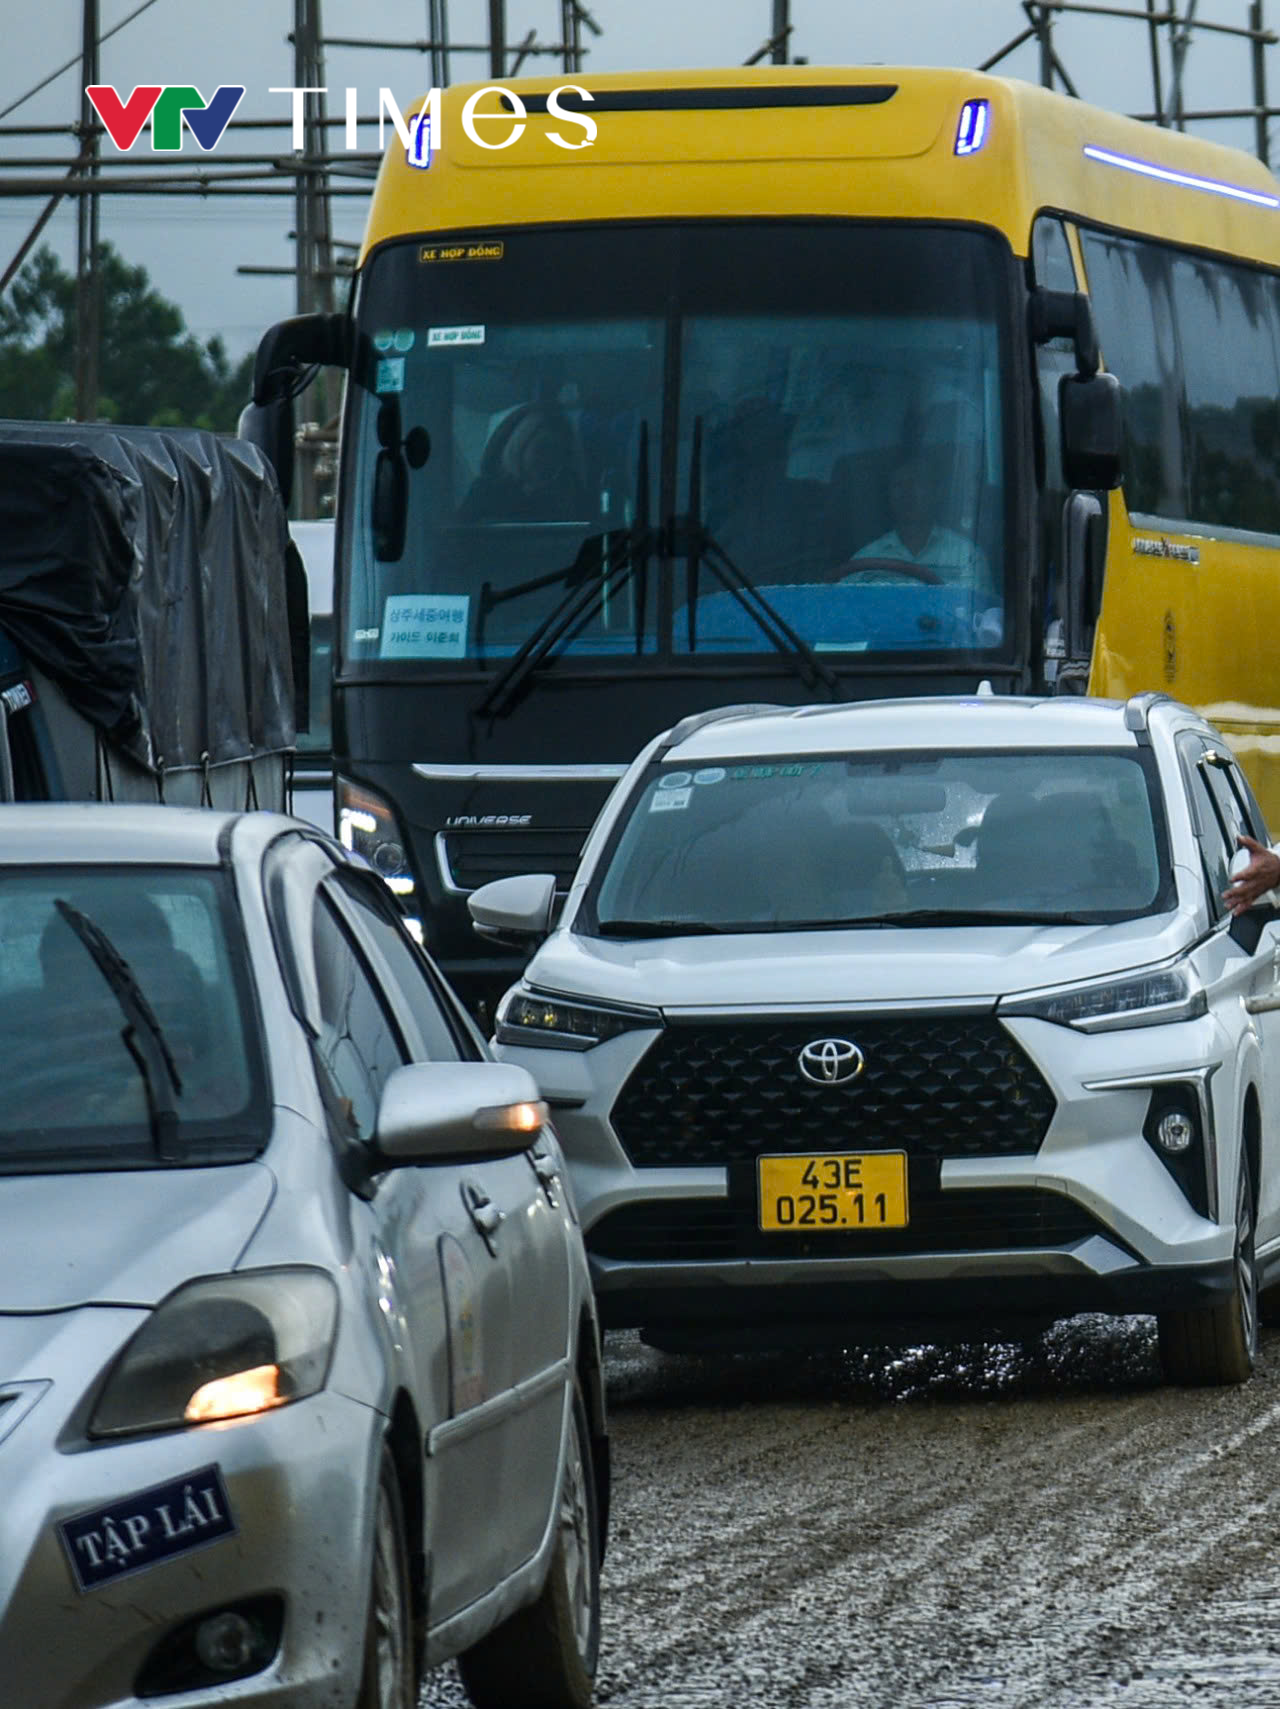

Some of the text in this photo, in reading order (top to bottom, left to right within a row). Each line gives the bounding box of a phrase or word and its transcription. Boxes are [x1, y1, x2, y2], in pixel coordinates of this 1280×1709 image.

[423, 244, 500, 259] XE HỢP ĐỒNG
[433, 332, 442, 341] XE
[445, 815, 532, 825] UNIVERSE
[802, 1159, 863, 1189] 43E
[776, 1193, 886, 1224] 025.11
[76, 1485, 223, 1567] TẬP LÁI
